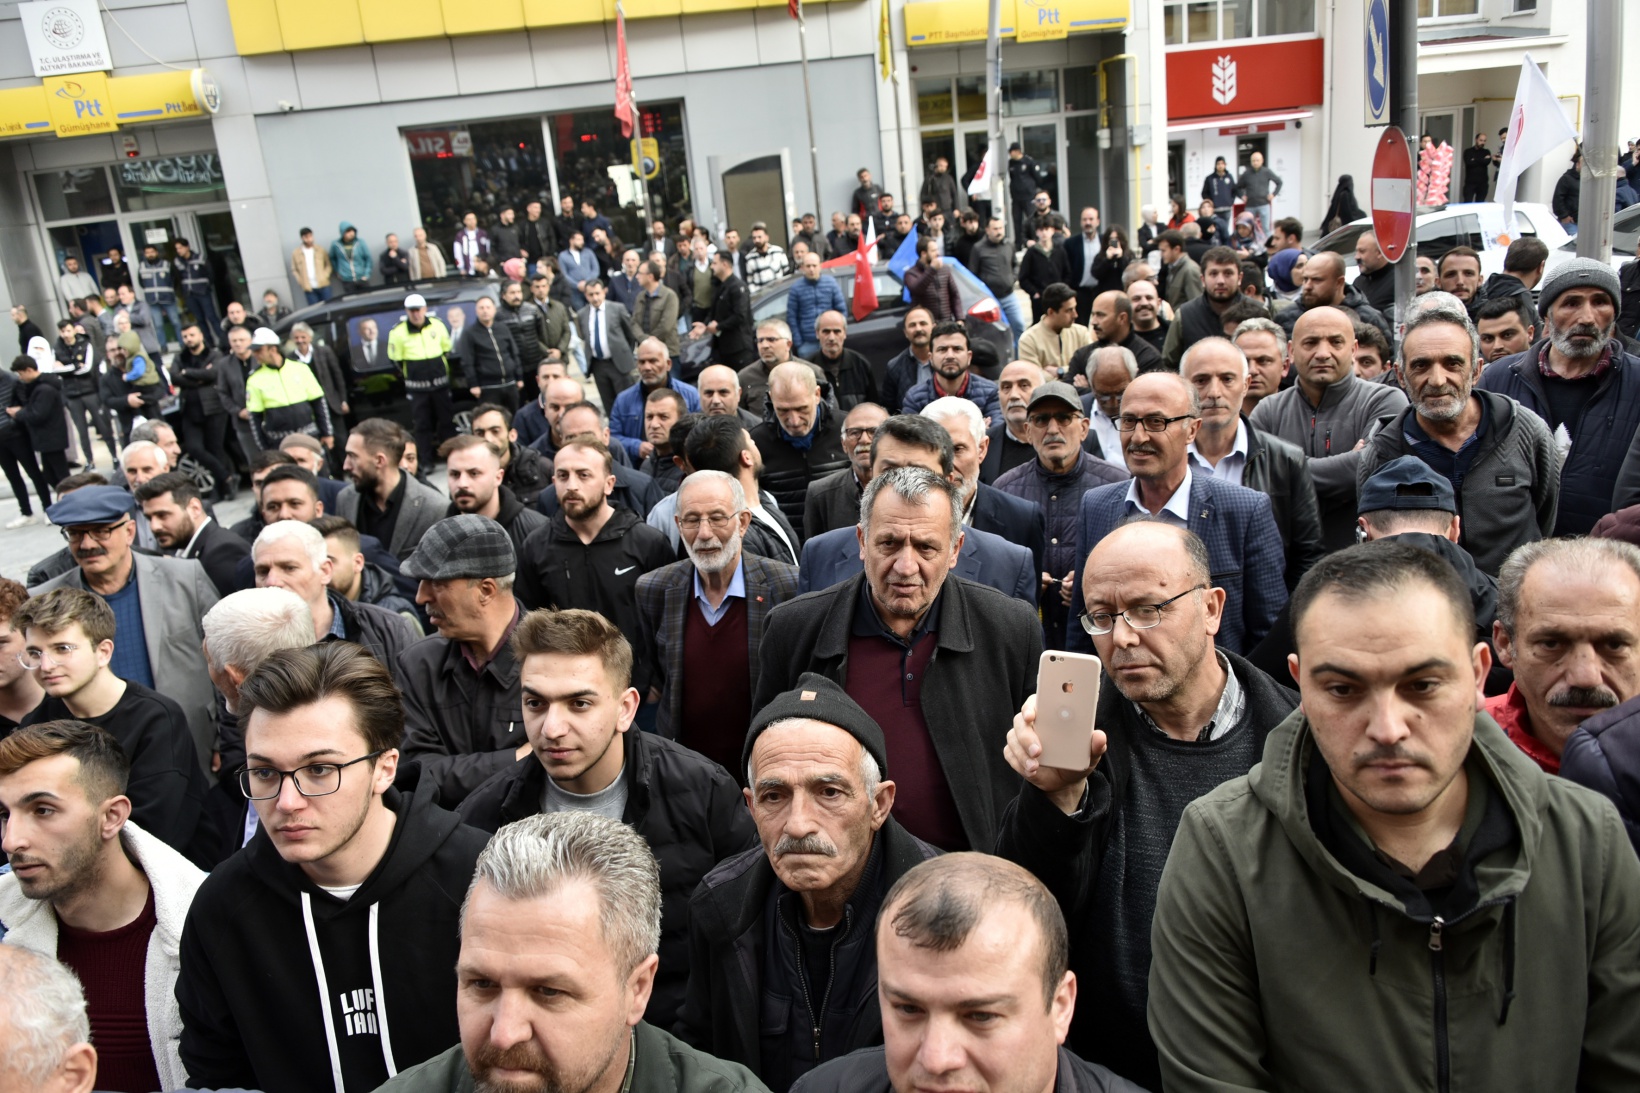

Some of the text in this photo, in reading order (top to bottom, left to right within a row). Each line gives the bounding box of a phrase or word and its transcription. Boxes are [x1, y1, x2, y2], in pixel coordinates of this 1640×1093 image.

[1038, 8, 1060, 25] Ptt
[928, 31, 942, 40] PTT
[1021, 28, 1063, 38] Gümüşhane
[52, 54, 91, 64] ULAŞTIRMA
[40, 59, 104, 72] ALTYAPI BAKANLIĞI
[74, 99, 104, 119] Ptt
[60, 121, 111, 133] Gümüşhane
[340, 988, 375, 1015] LUF
